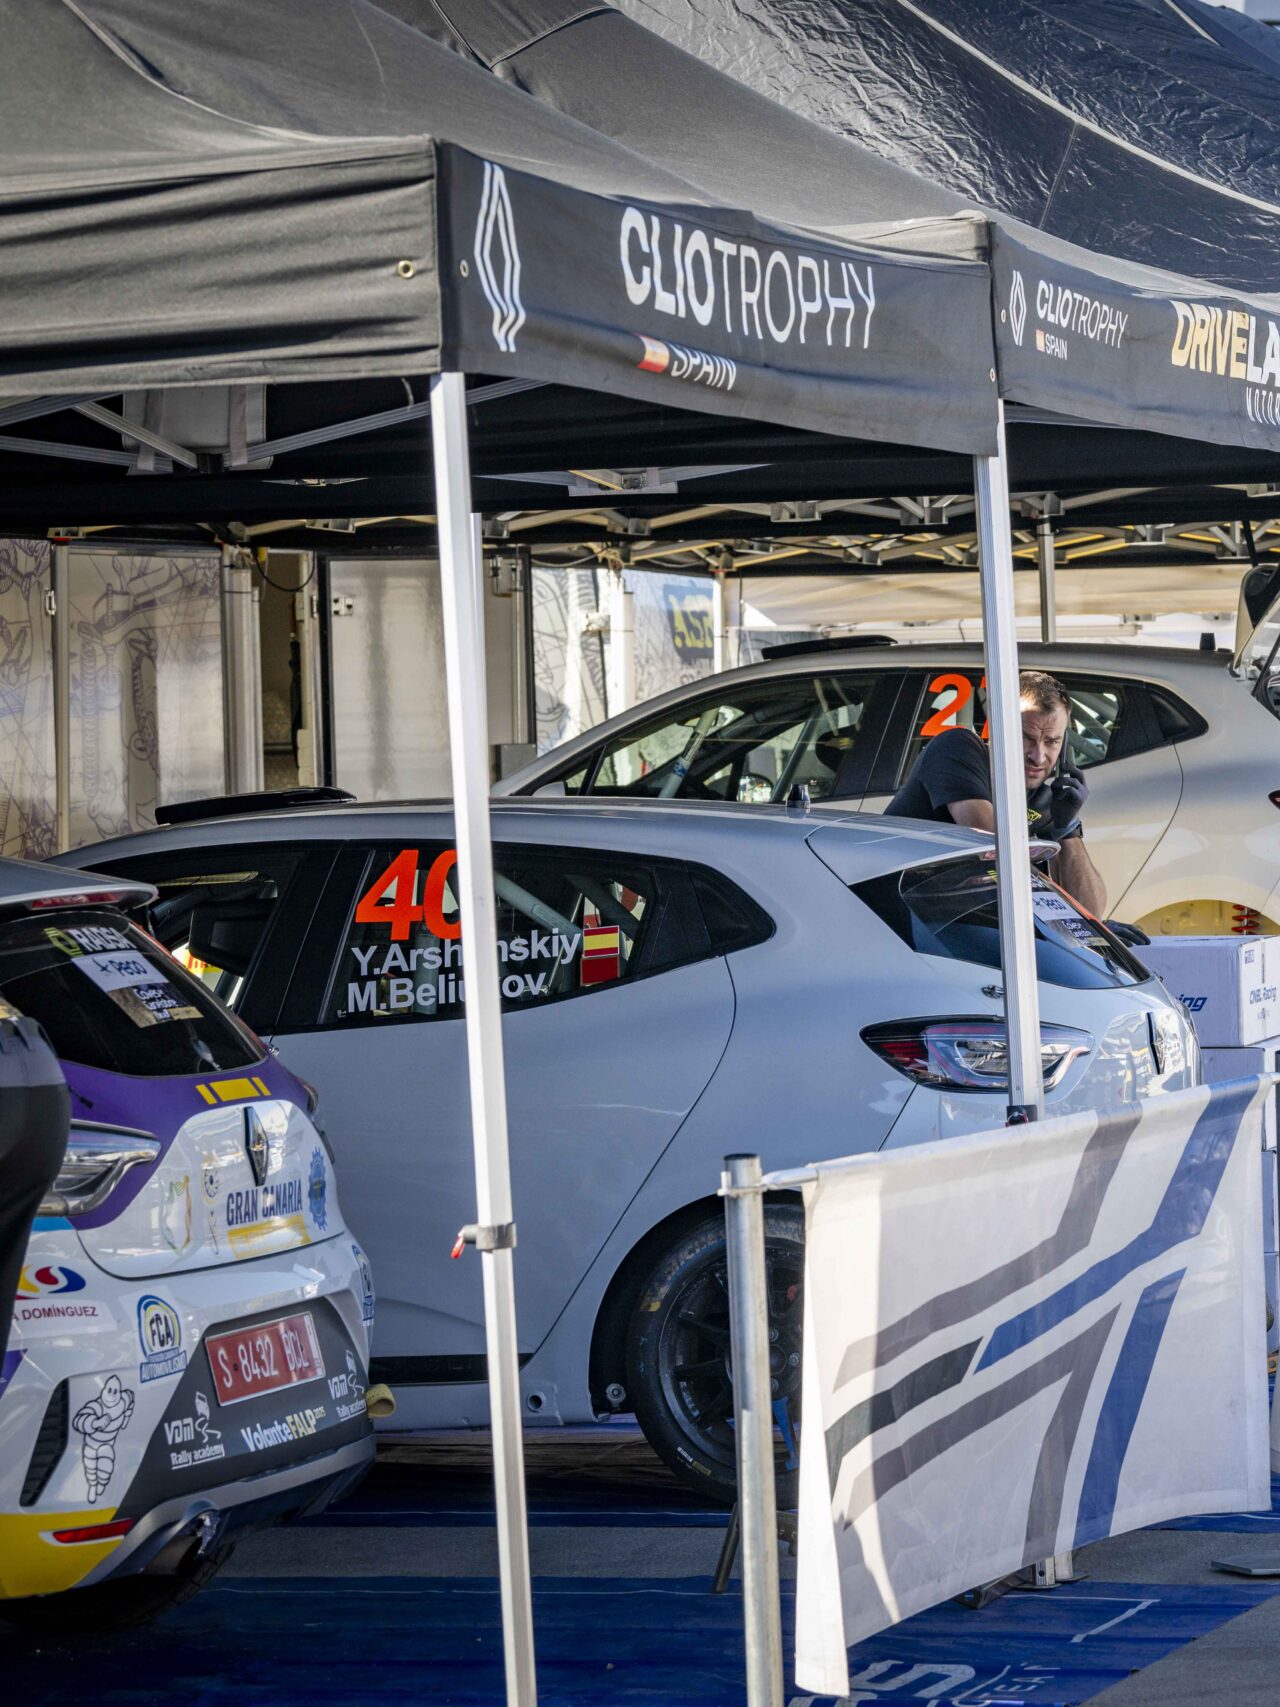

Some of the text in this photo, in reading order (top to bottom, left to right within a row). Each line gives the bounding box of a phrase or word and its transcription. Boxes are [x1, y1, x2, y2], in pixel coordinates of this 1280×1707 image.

[620, 206, 876, 349] CLIOTROPHY
[1036, 279, 1129, 349] CLIOTROPHY
[670, 344, 737, 391] SPAIN
[1045, 333, 1068, 360] SPAIN
[351, 927, 582, 976] Y.Arshnskiy
[226, 1178, 303, 1226] GRAN CANARIA
[21, 1304, 99, 1321] DOMÍNGUEZ
[149, 1312, 174, 1348] FCA
[217, 1346, 233, 1388] S
[238, 1335, 279, 1383] 8432
[170, 1443, 226, 1466] Rally academy
